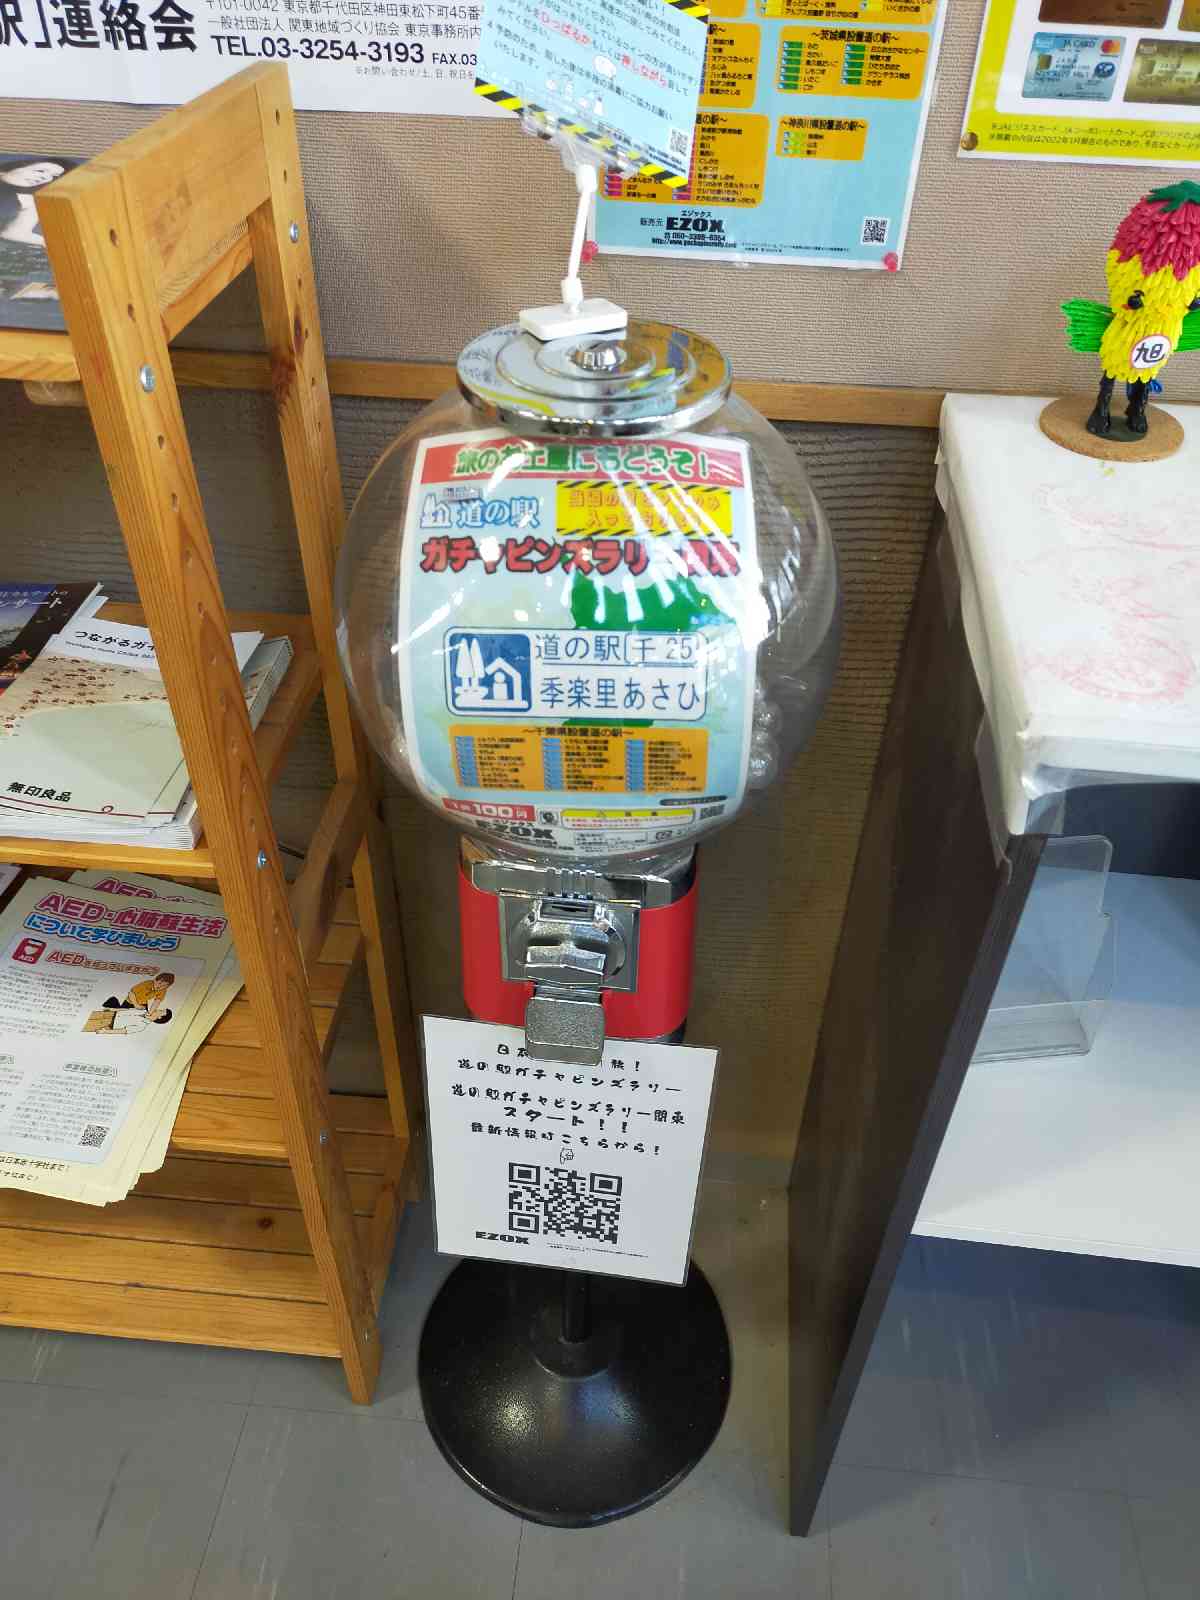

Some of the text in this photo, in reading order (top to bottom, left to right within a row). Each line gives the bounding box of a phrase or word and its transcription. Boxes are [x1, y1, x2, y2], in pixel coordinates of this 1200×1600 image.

[208, 16, 284, 32] 一般社団法人
[284, 0, 483, 20] 東京都千代田区神田東松下町45番
[210, 35, 425, 64] TEL.03-3254-3193
[665, 216, 725, 233] EZOX
[1134, 343, 1166, 364] 旭
[539, 676, 700, 711] 季楽里あさひ
[7, 781, 72, 803] 無印良品
[35, 892, 227, 938] AED・心肺蘇生法
[24, 913, 180, 950] について学びましょう
[457, 1057, 682, 1094] 道の駅ガチャピンズラリー
[451, 1083, 686, 1126] 道の駅ガチャピンズラリー関東
[471, 1121, 661, 1156] 最新情報はこちらから！
[475, 1230, 531, 1246] EZOX
